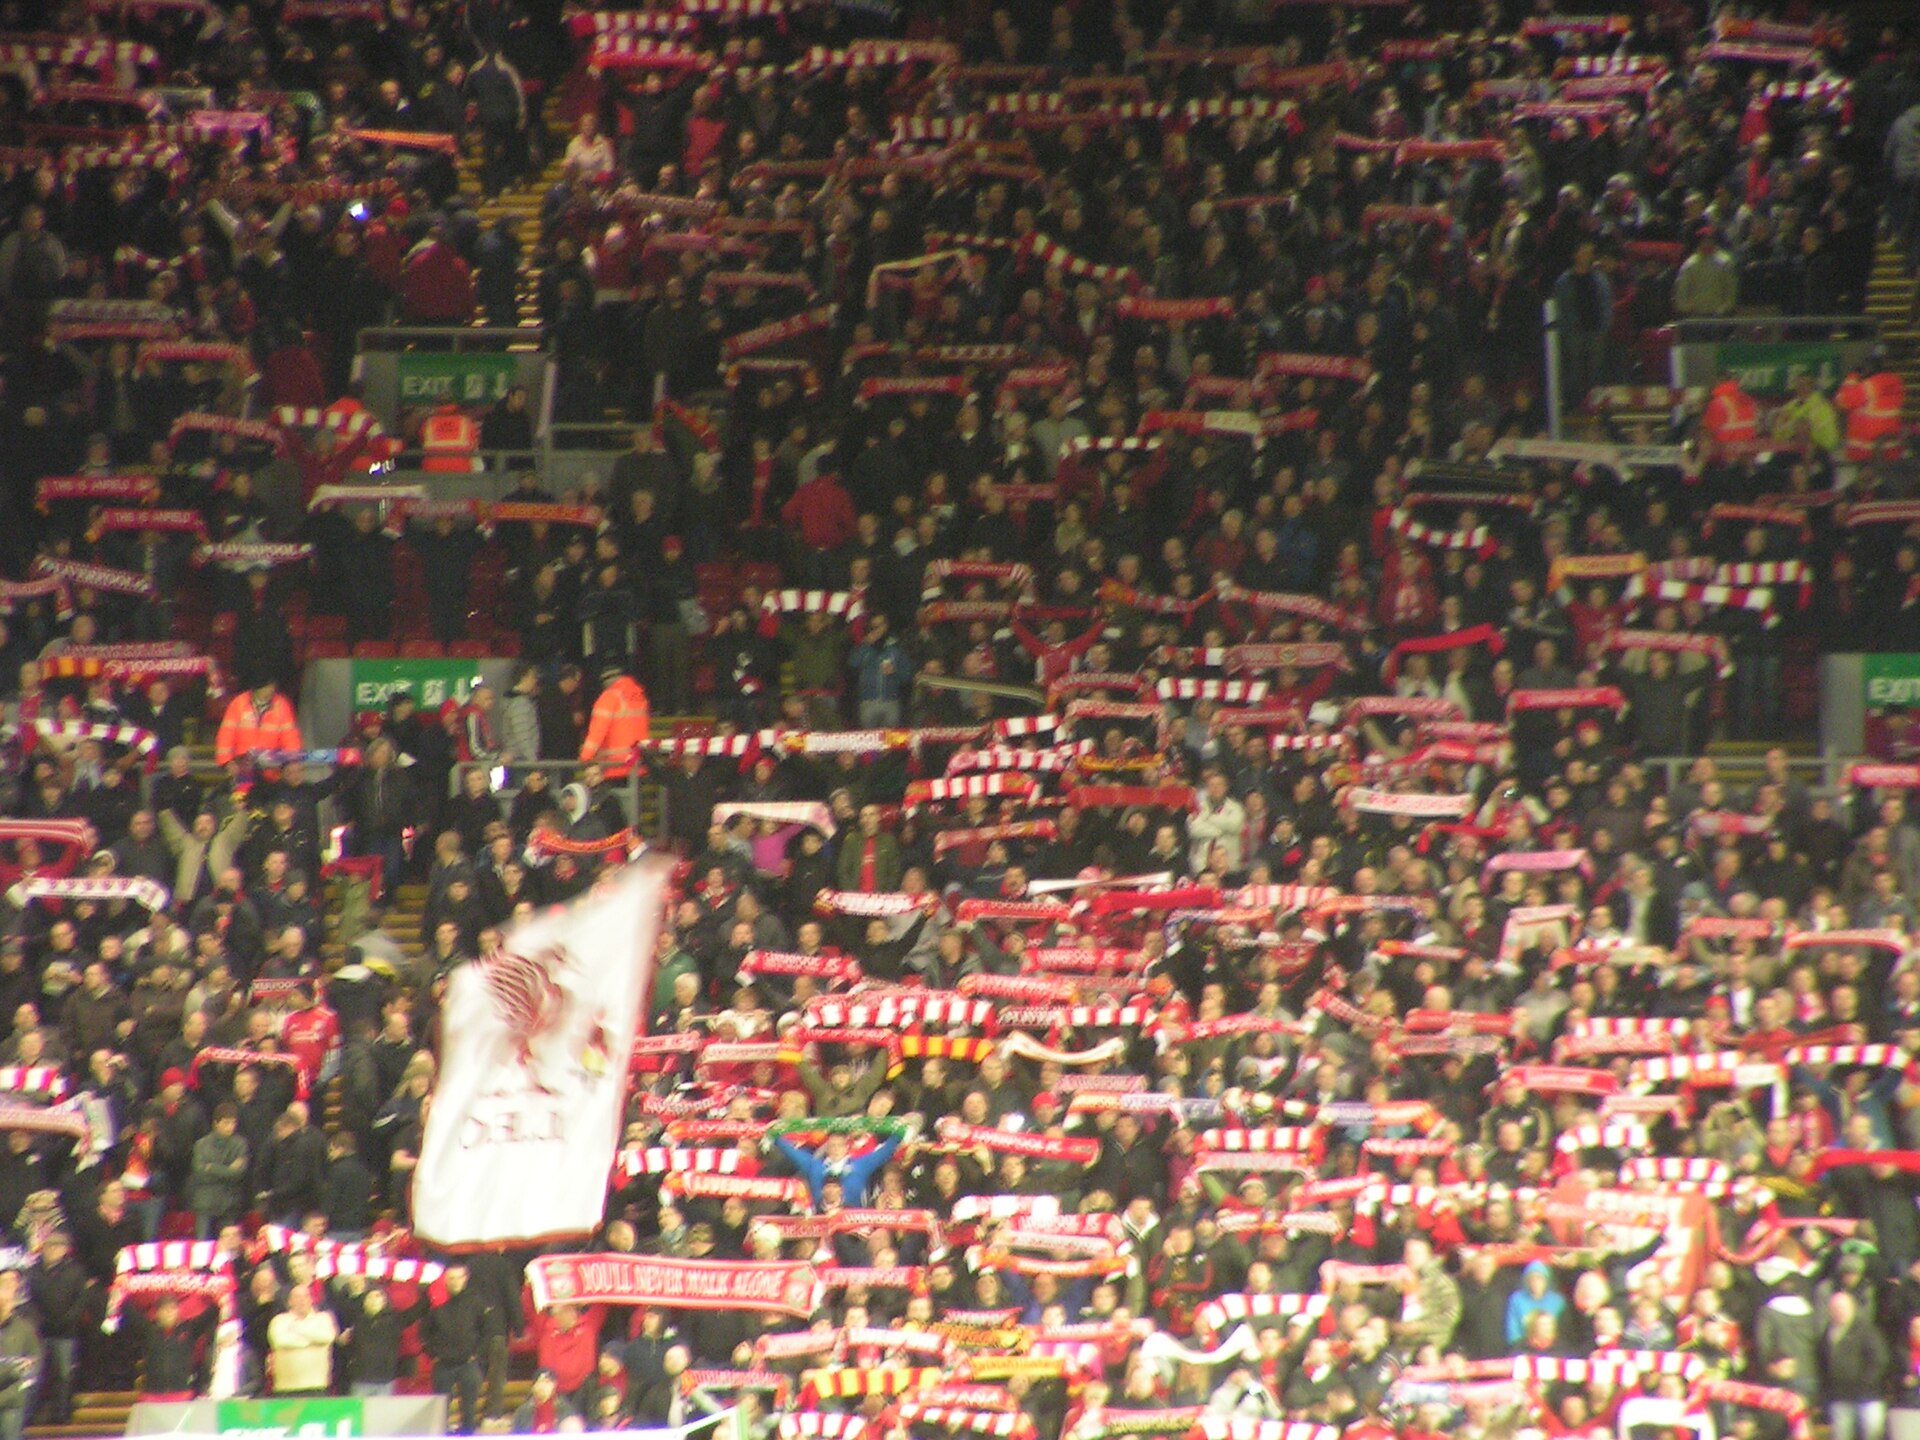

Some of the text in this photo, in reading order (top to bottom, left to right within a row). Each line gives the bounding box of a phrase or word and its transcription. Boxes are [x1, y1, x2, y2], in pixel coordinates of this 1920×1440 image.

[404, 376, 454, 396] EXIT
[579, 1263, 786, 1298] YOU'LL NEVER WALK ALONE
